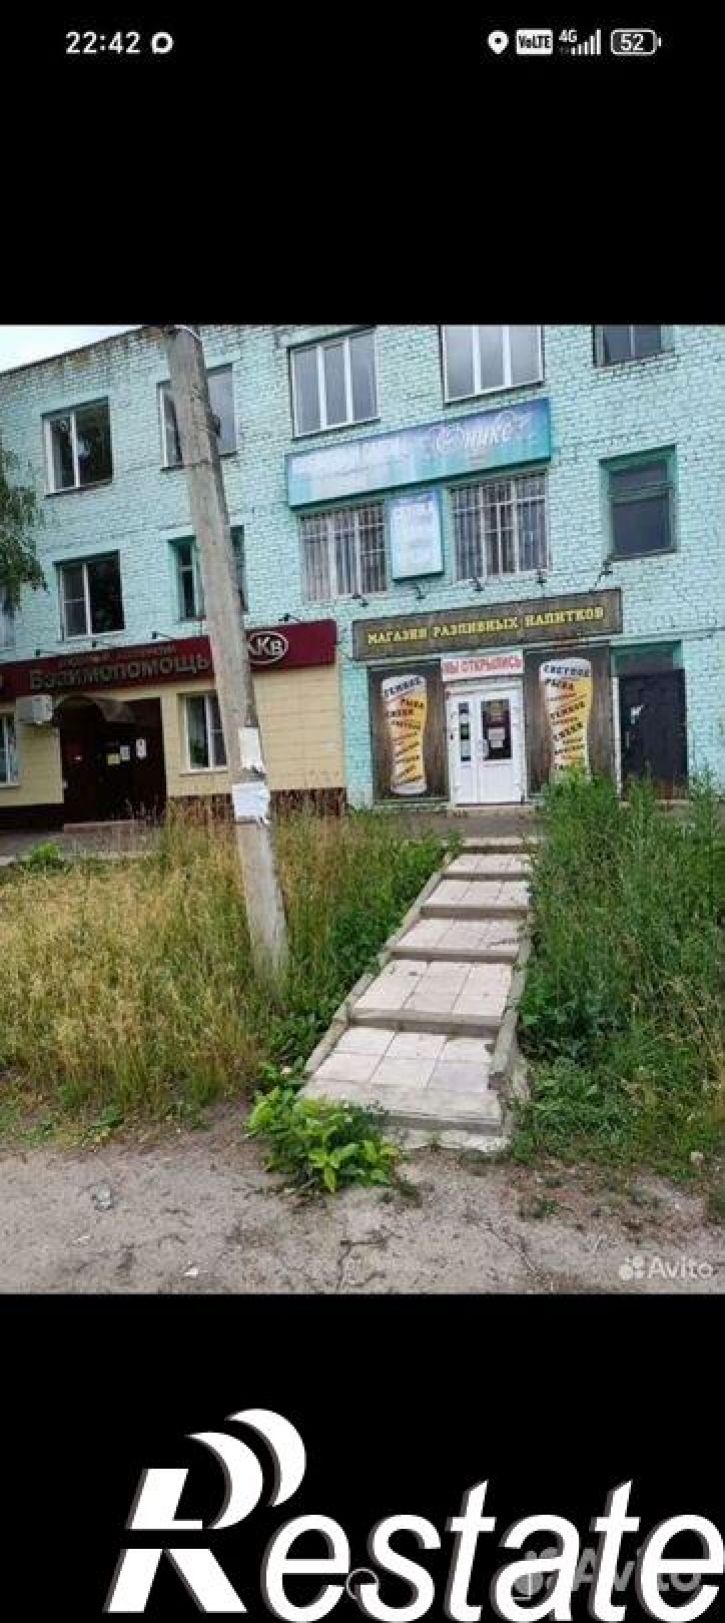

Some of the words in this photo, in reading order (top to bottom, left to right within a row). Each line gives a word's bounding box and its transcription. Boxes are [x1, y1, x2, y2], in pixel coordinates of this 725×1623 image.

[65, 31, 141, 55] 22:42
[558, 29, 578, 43] 4G
[620, 33, 645, 51] 52
[367, 627, 427, 645] МАГАЗИН
[525, 606, 604, 628] НАПИТКОВ
